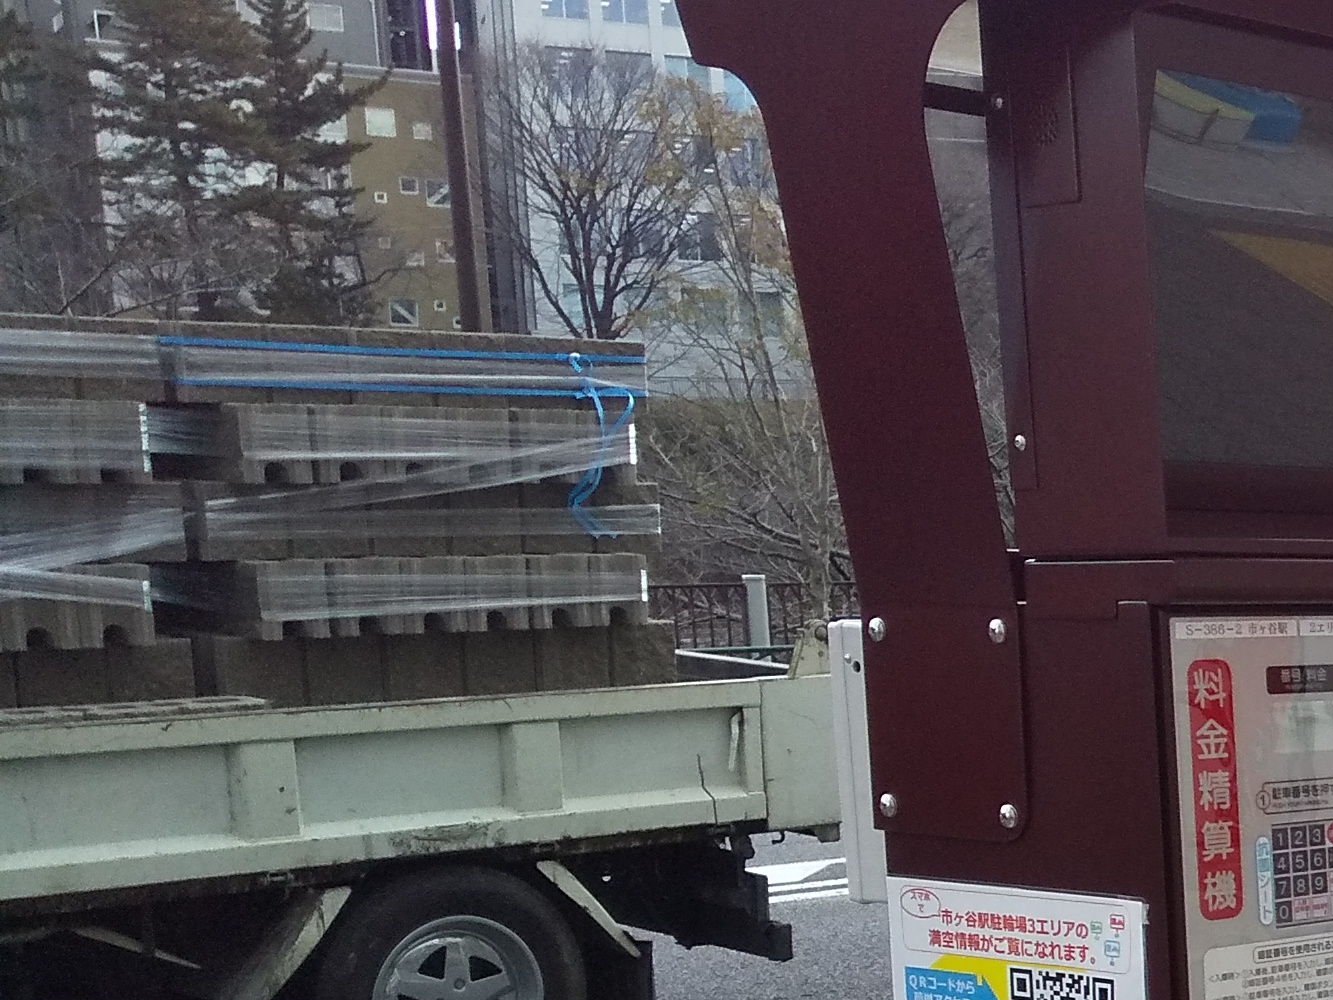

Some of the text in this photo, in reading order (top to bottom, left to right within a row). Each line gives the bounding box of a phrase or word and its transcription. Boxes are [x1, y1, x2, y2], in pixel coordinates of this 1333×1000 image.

[1186, 624, 1243, 636] S-386-2
[1192, 667, 1238, 912] 料金精算機
[1277, 832, 1284, 846] 1
[1294, 831, 1304, 845] 2
[1312, 828, 1321, 842] 3
[1277, 857, 1287, 871] 4
[1295, 855, 1305, 869] 5
[1313, 853, 1323, 867] 6
[1278, 881, 1287, 895] 7
[1296, 879, 1306, 893] 8
[1314, 876, 1324, 890] 9
[1279, 905, 1289, 920] 0
[928, 929, 1096, 965] 満空情報がご覧になれます。
[909, 974, 975, 995] QRコードから
